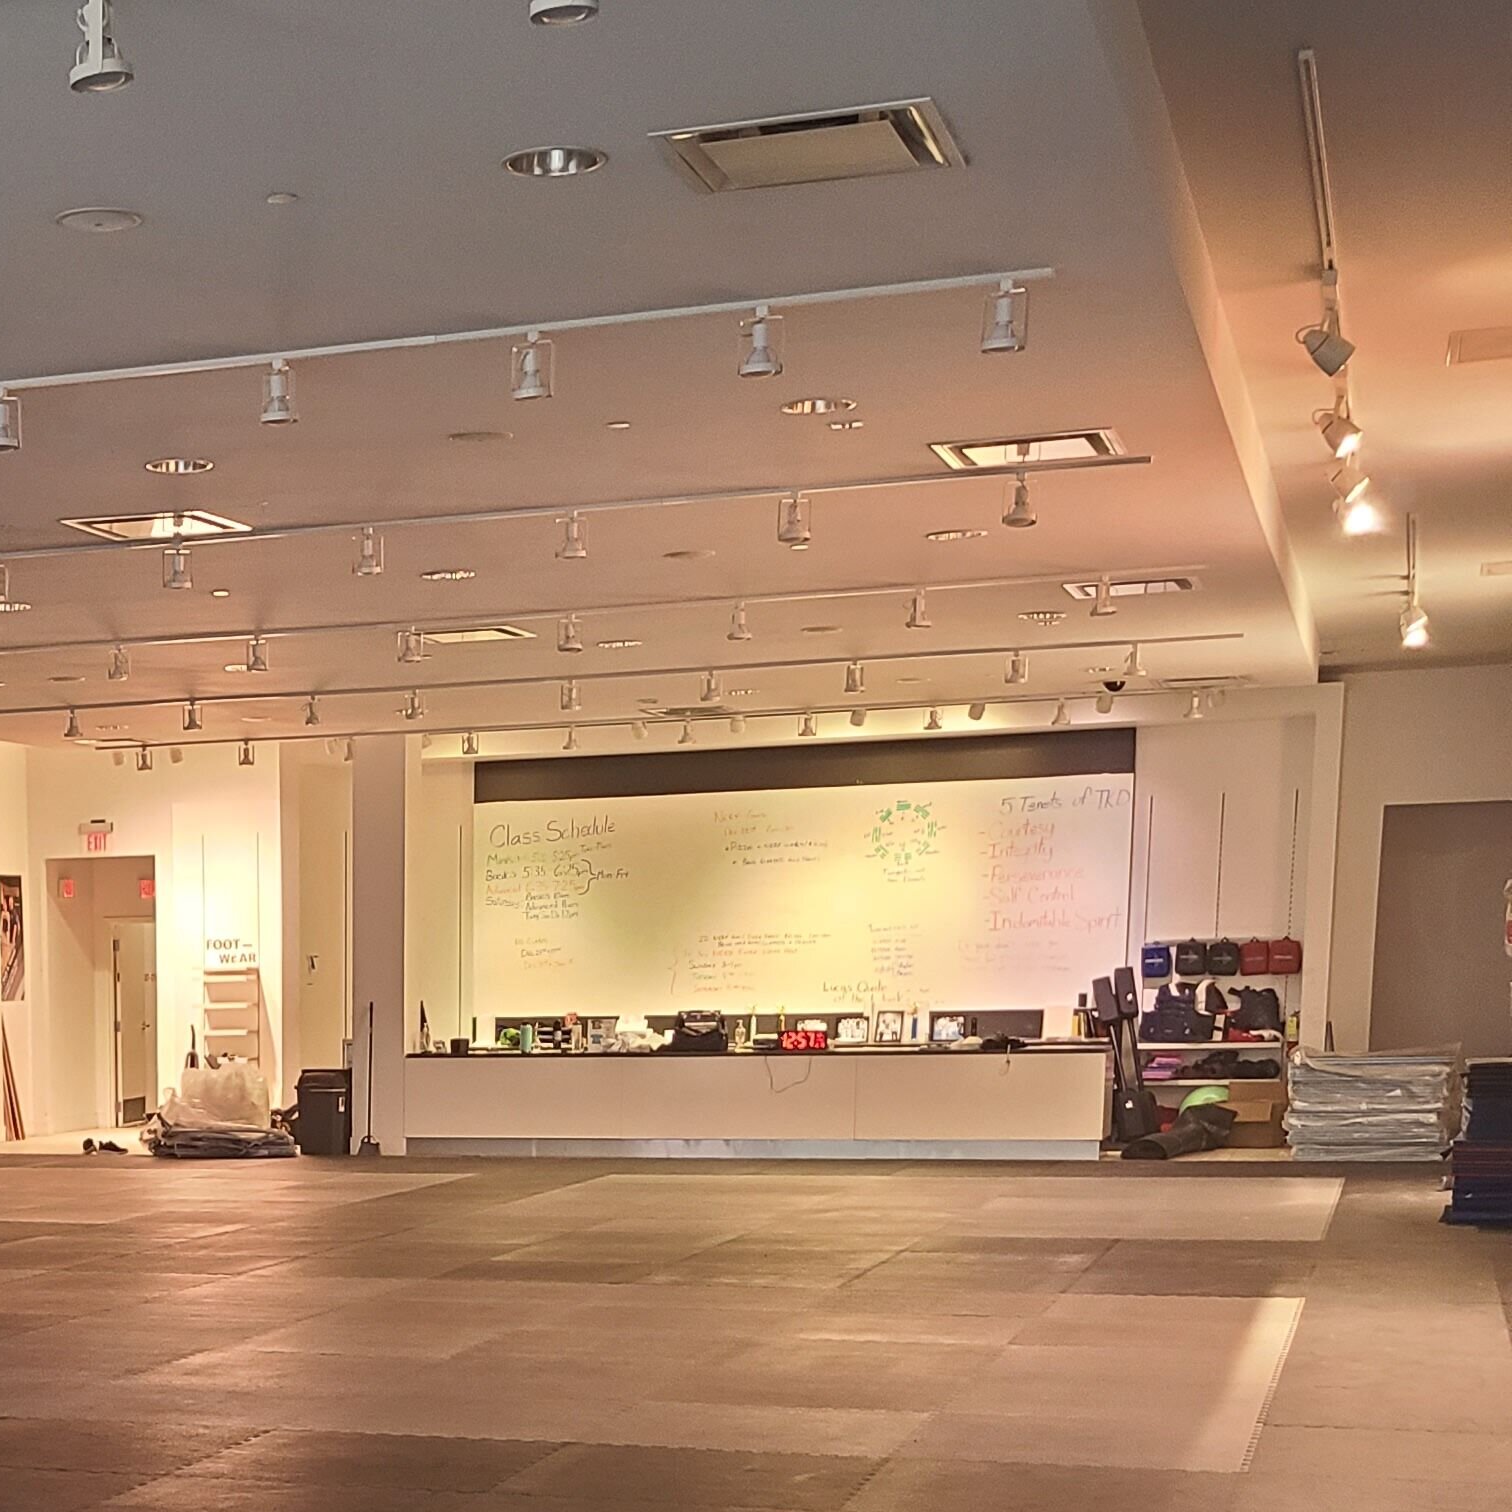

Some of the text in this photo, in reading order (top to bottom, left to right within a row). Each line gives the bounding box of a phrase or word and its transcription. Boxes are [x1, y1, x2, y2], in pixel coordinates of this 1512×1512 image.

[87, 832, 107, 852] EXIT
[489, 814, 617, 848] Class Schedule
